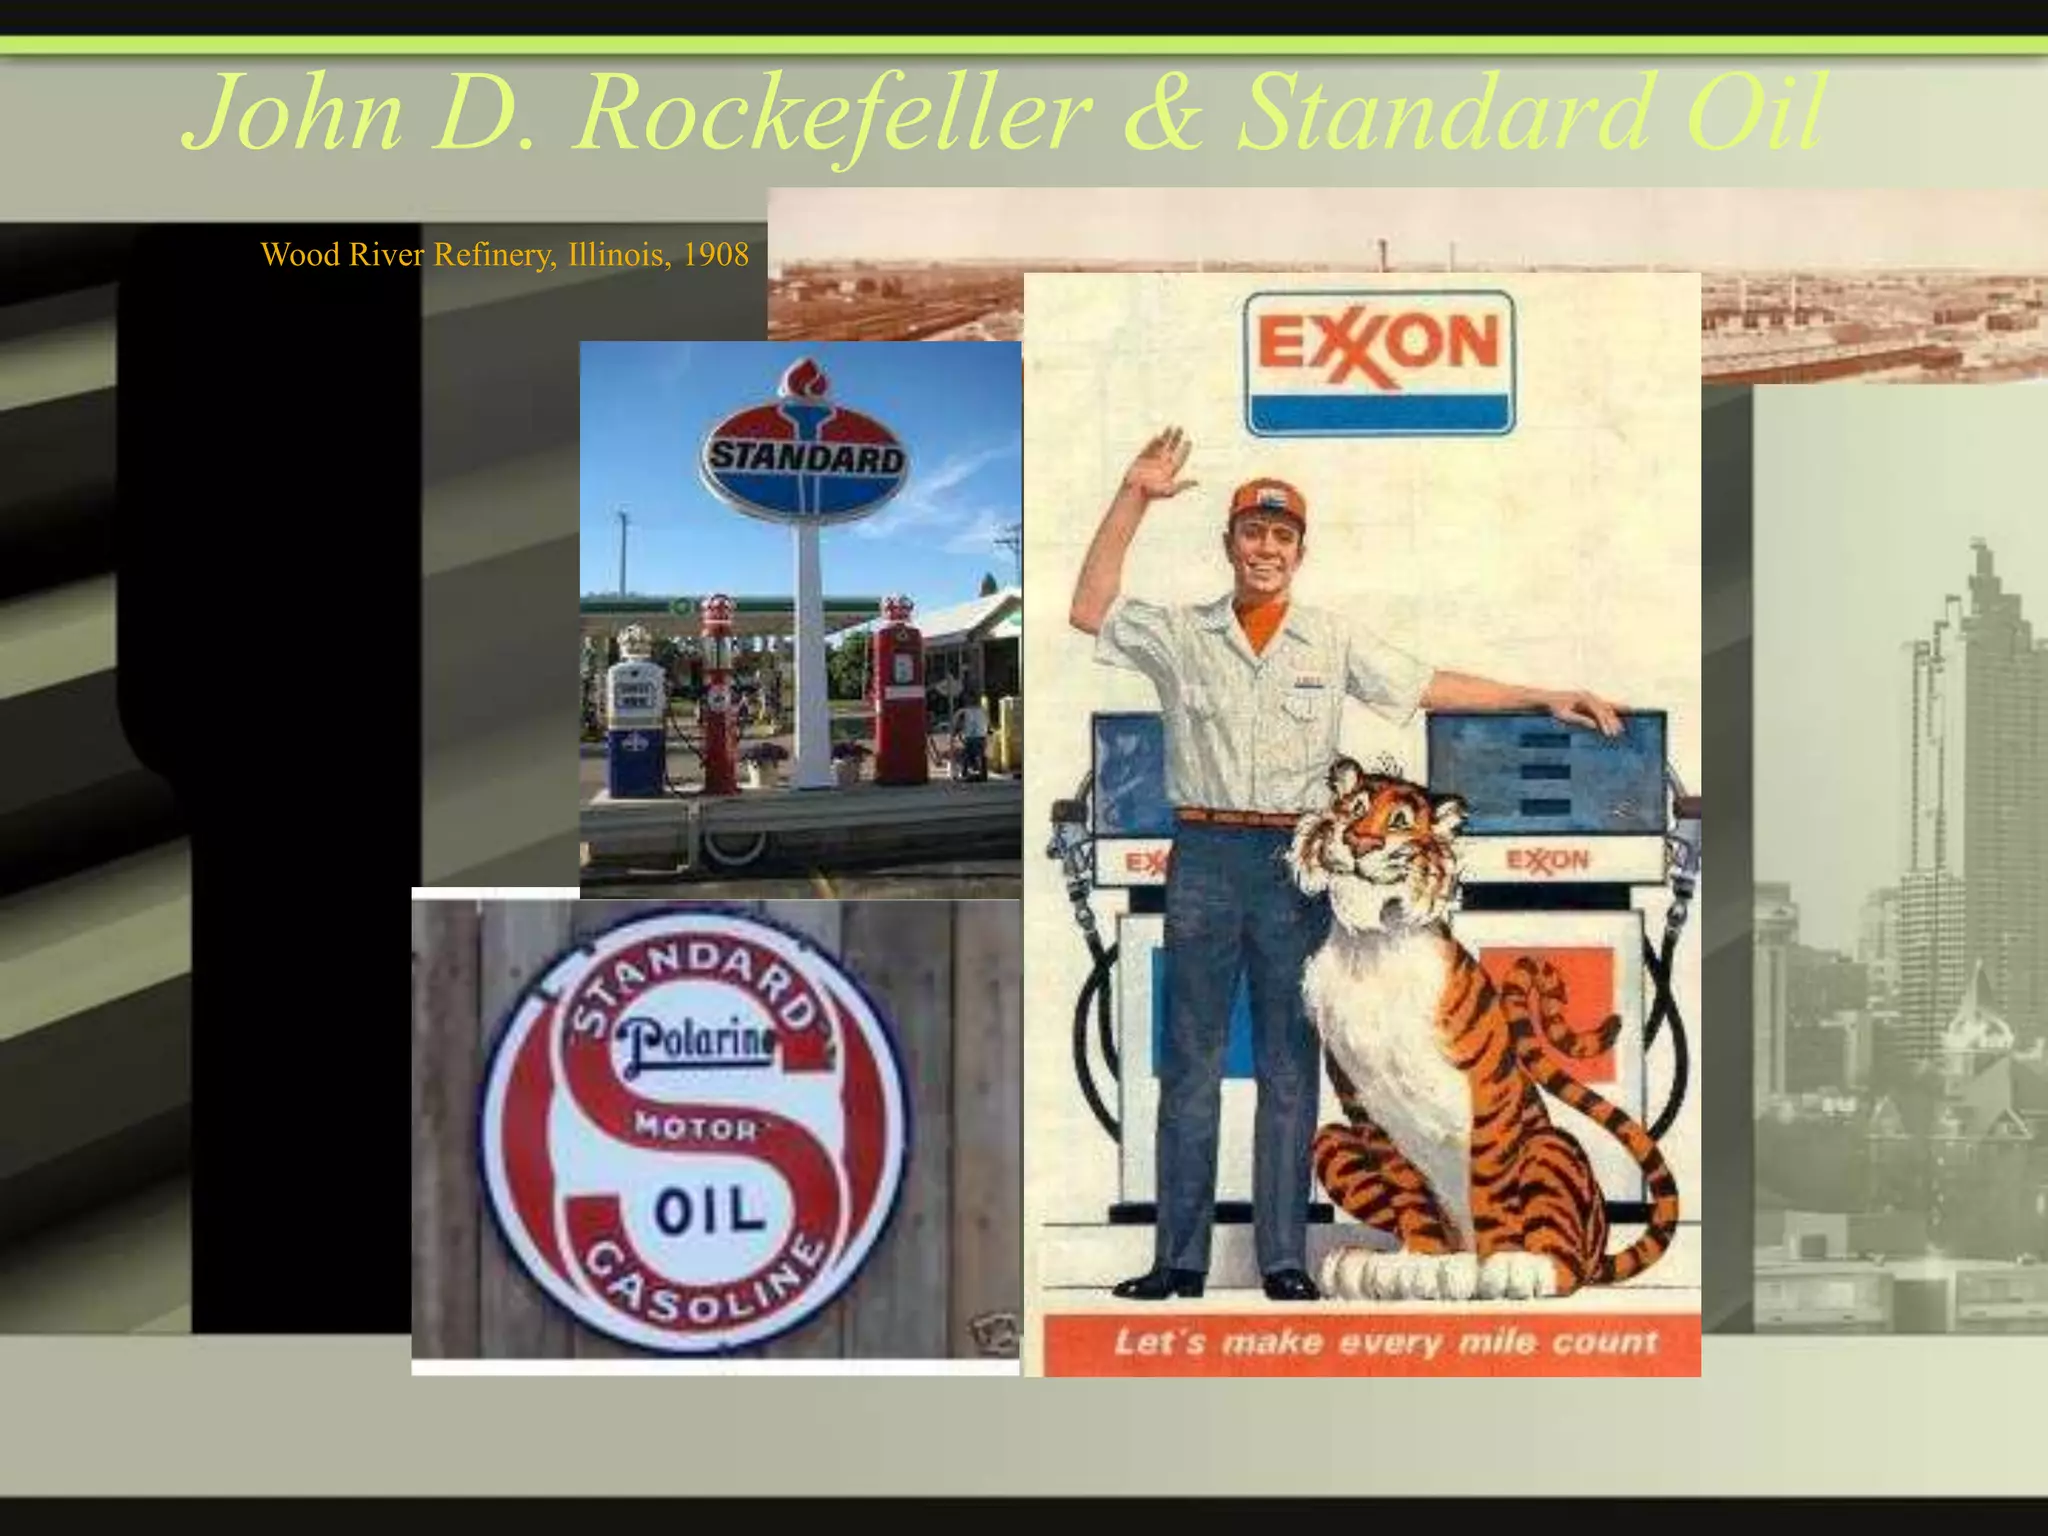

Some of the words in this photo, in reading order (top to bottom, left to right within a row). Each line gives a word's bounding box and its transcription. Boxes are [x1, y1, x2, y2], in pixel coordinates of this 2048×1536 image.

[1258, 307, 1499, 389] EXXON
[708, 440, 907, 475] STANDARD
[1506, 848, 1589, 875] EXXON
[573, 941, 818, 1038] STANDARD
[634, 1110, 757, 1141] MOTOR
[655, 1186, 766, 1236] OIL
[586, 1232, 825, 1324] GASOLINE
[1115, 1326, 1207, 1356] Let's
[1222, 1326, 1325, 1356] make
[1340, 1332, 1443, 1362] every
[1457, 1326, 1539, 1356] mile
[1552, 1328, 1660, 1356] count
